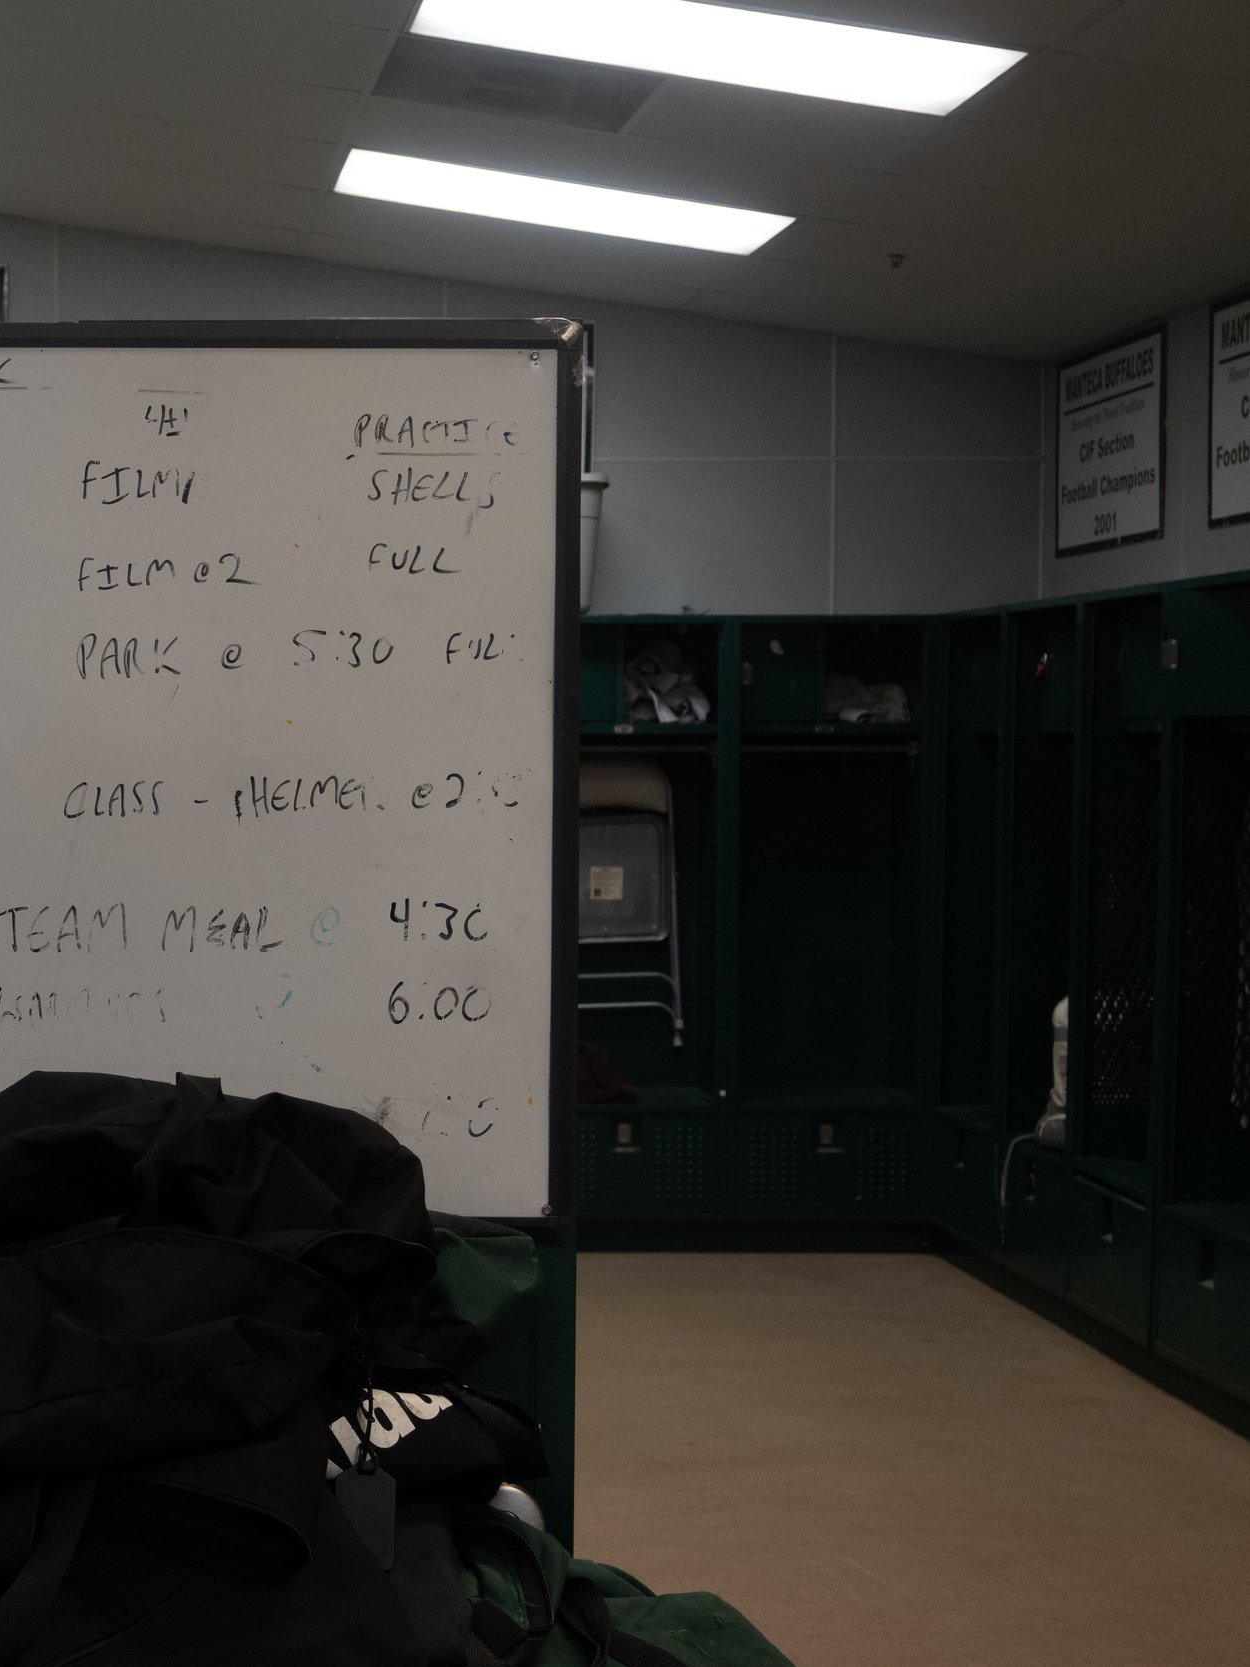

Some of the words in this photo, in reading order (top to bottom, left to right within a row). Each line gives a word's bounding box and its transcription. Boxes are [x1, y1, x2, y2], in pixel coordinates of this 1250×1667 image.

[1065, 364, 1103, 402] MANTECA
[1105, 347, 1154, 390] BUFFALOES
[1079, 442, 1095, 463] CIF
[1097, 431, 1135, 458] Section
[367, 467, 503, 510] SHELLS
[1061, 477, 1098, 505] Football
[1099, 466, 1156, 497] Champions
[1093, 512, 1118, 536] 2001
[78, 557, 176, 592] FILM
[368, 543, 459, 575] FULL
[75, 632, 182, 682] PARK
[292, 629, 394, 669] 5:30
[62, 780, 163, 818] CLASS
[161, 905, 283, 953] MEAL
